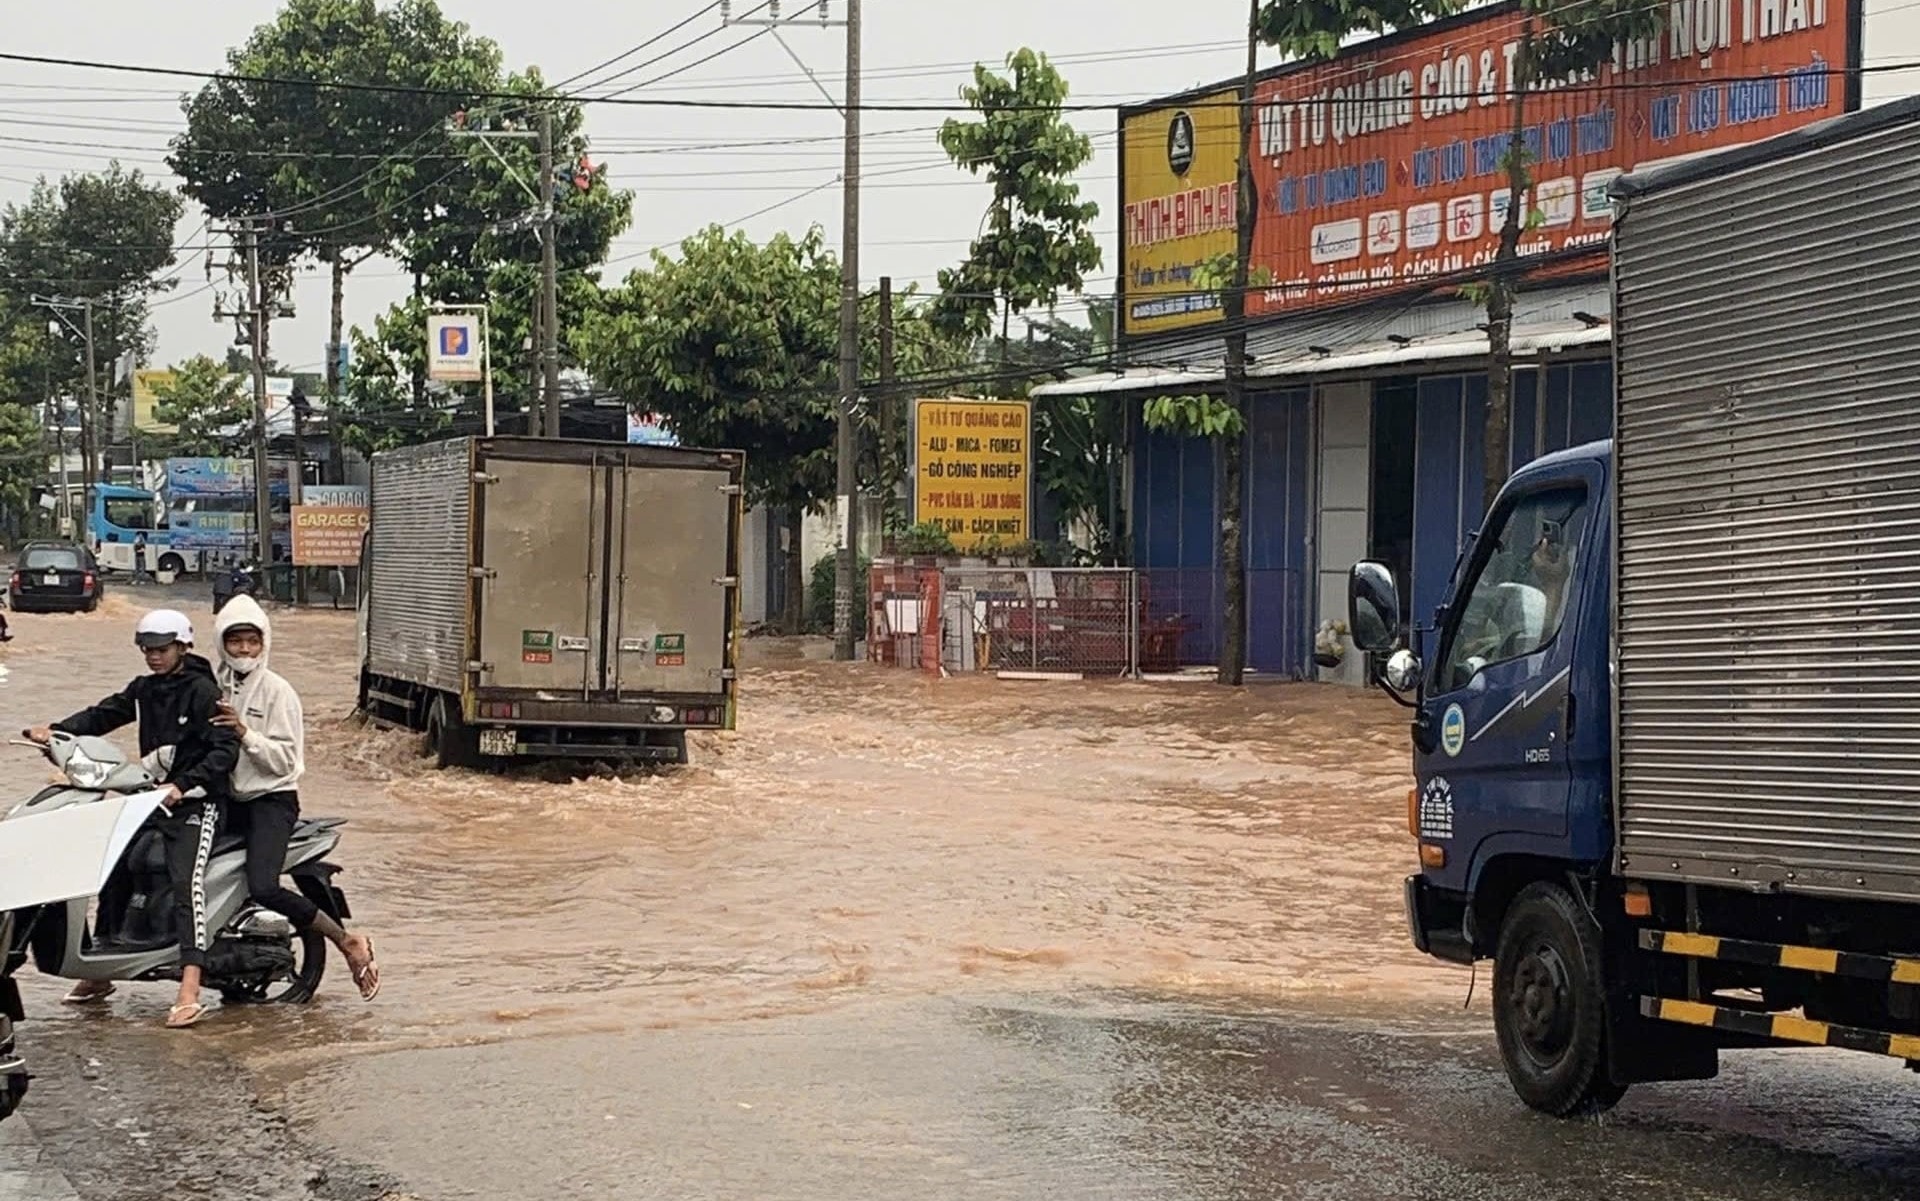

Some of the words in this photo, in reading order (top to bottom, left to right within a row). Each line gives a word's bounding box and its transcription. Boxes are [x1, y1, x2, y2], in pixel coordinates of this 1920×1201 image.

[1258, 93, 1296, 168] VẬT
[1298, 87, 1328, 148] TƯ
[1420, 48, 1472, 120] CÁO
[1478, 48, 1498, 107] &
[1002, 409, 1022, 428] CÁO
[929, 437, 947, 452] ALU
[956, 437, 981, 452] MICA
[989, 438, 1022, 453] FOMEX
[981, 461, 1022, 482] NGHIỆP
[297, 513, 356, 527] GARAGE
[1525, 748, 1550, 763] HD65
